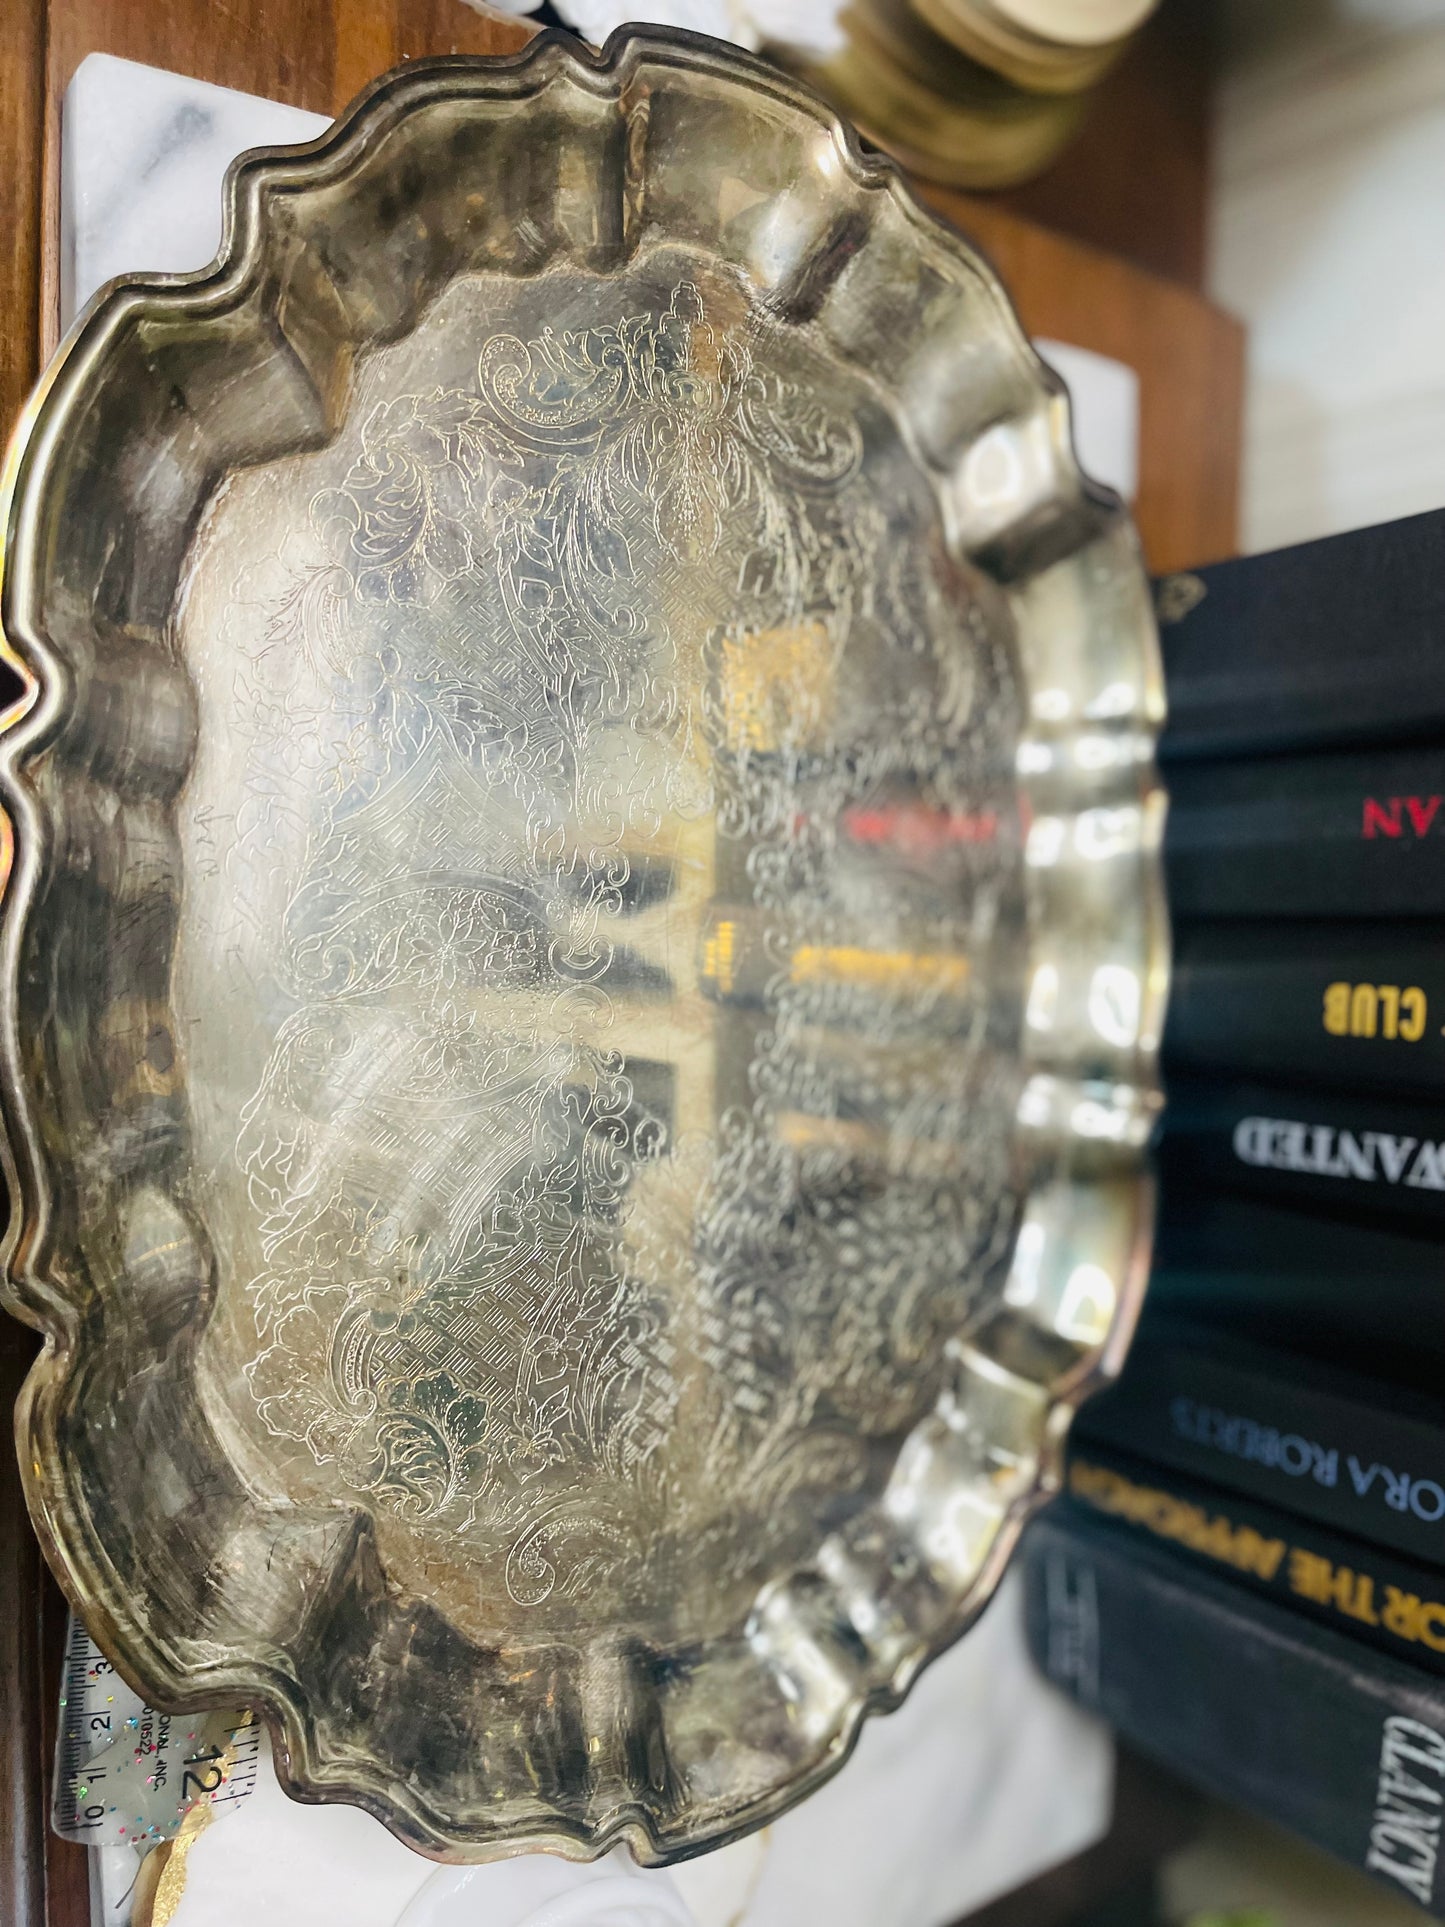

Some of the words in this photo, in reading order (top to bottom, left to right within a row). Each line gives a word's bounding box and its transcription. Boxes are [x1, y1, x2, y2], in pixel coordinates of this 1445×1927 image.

[1361, 795, 1443, 840] AN
[1323, 981, 1427, 1042] CLUB
[1233, 1115, 1445, 1192] WANTED
[1346, 1454, 1445, 1522] ORA
[1288, 1546, 1379, 1627] THE
[95, 1661, 114, 1675] 3
[91, 1715, 111, 1731] 2
[86, 1774, 107, 1785] 1
[183, 1744, 224, 1800] 12
[84, 1805, 104, 1820] 0
[1364, 1715, 1445, 1905] CLANCY
